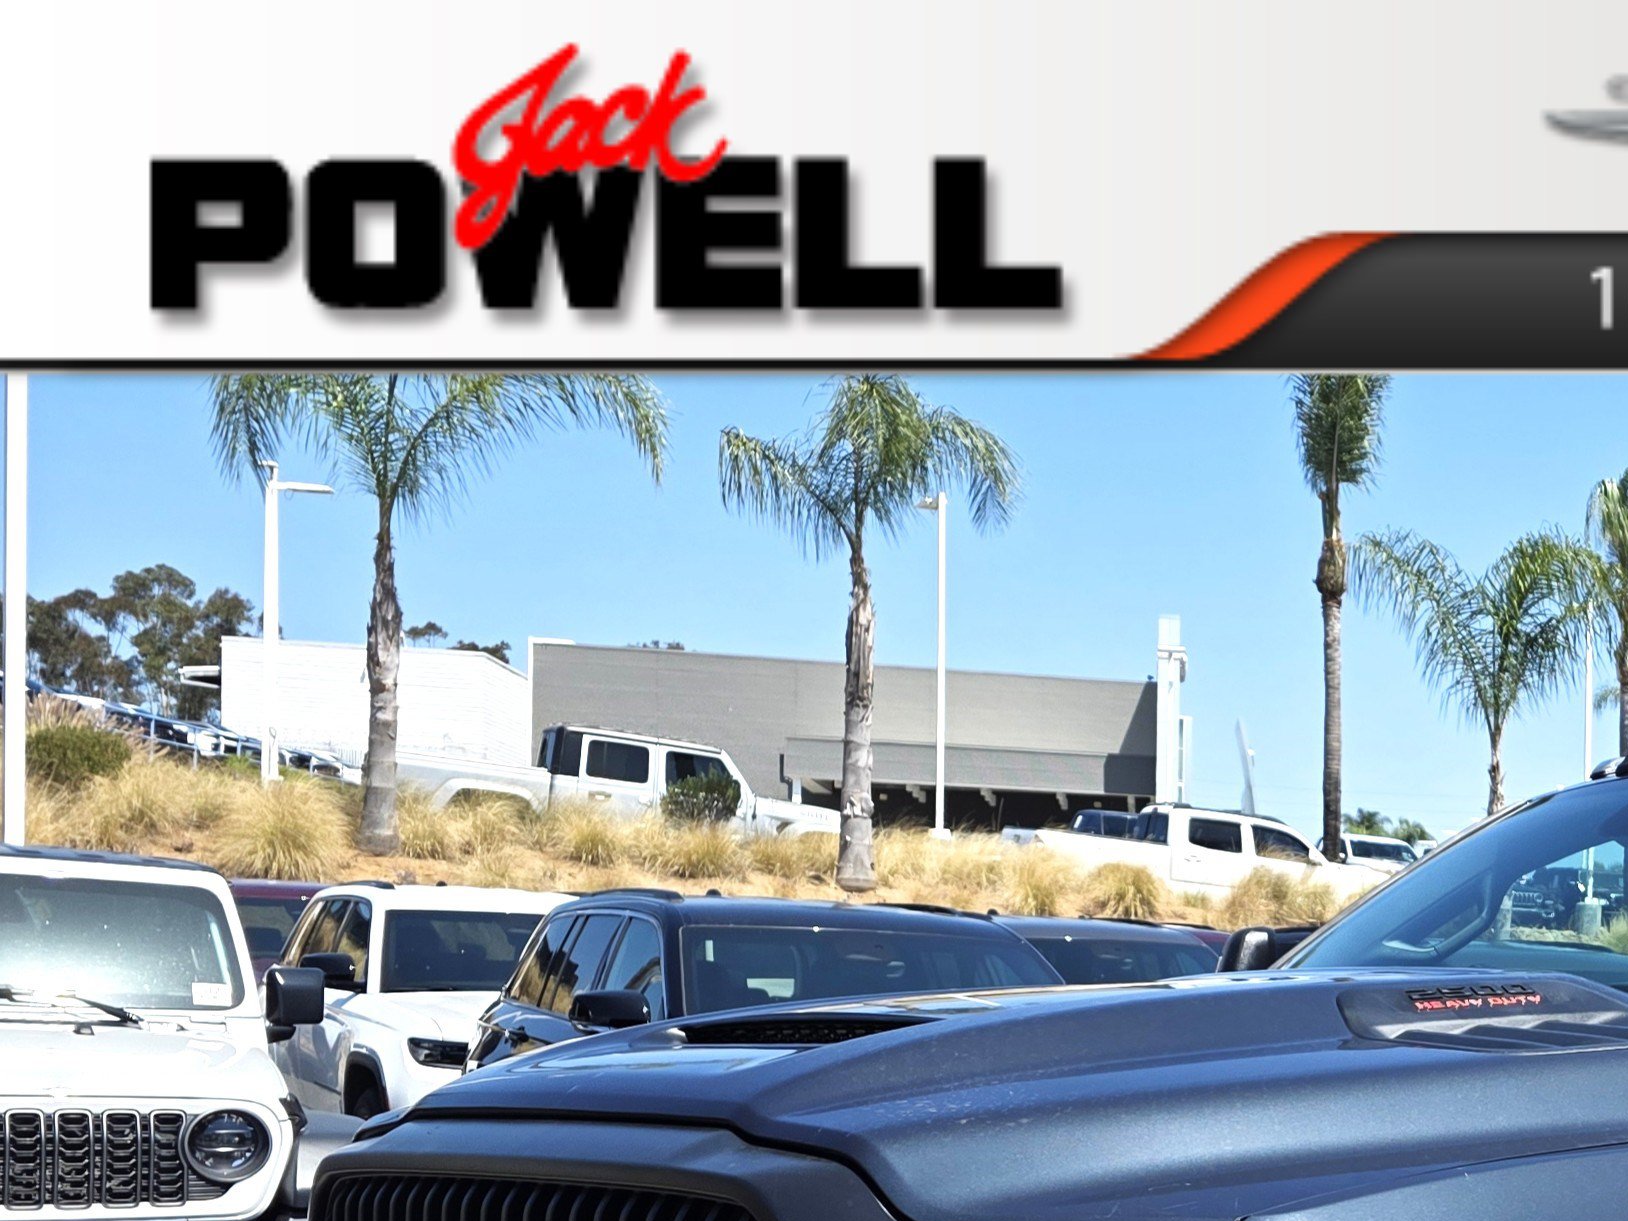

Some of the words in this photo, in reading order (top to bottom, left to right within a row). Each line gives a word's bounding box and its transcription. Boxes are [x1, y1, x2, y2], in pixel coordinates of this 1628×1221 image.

[1405, 984, 1536, 1001] 2500
[1414, 999, 1483, 1012] HEAVY
[1487, 994, 1541, 1008] DUTY
